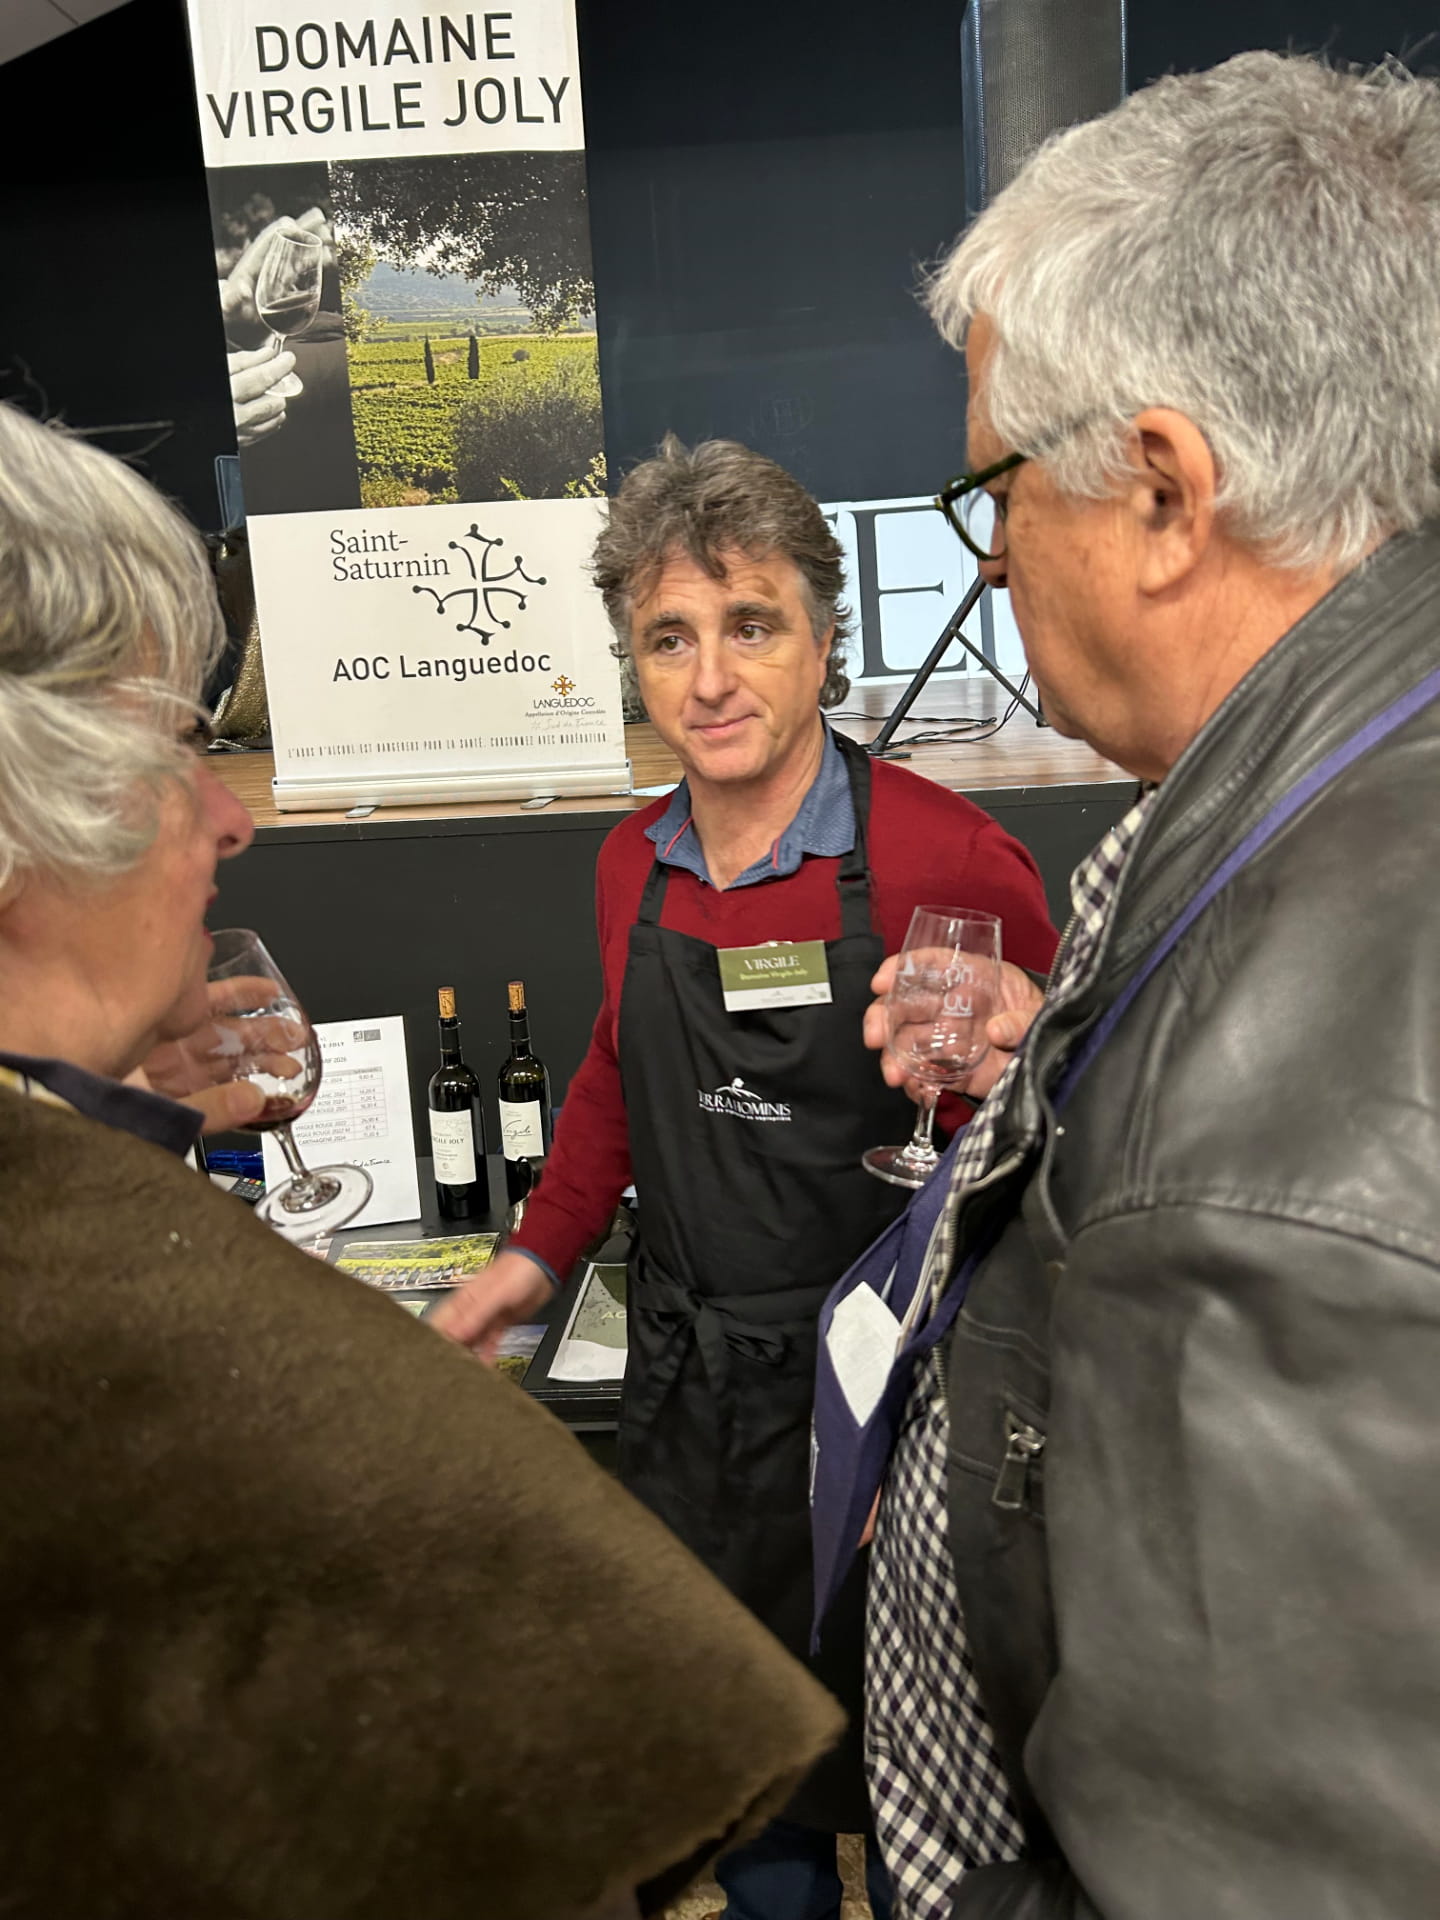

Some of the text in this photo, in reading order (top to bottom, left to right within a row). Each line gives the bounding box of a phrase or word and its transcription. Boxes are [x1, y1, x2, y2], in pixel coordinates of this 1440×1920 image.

[255, 12, 516, 73] DOMAINE
[206, 76, 571, 139] VIRGILE JOLY
[330, 528, 409, 556] Saint-
[332, 552, 451, 582] Saturnin
[333, 649, 552, 682] AOC Languedoc
[533, 696, 596, 710] LANGUEDOC
[744, 954, 801, 971] VIRGILE
